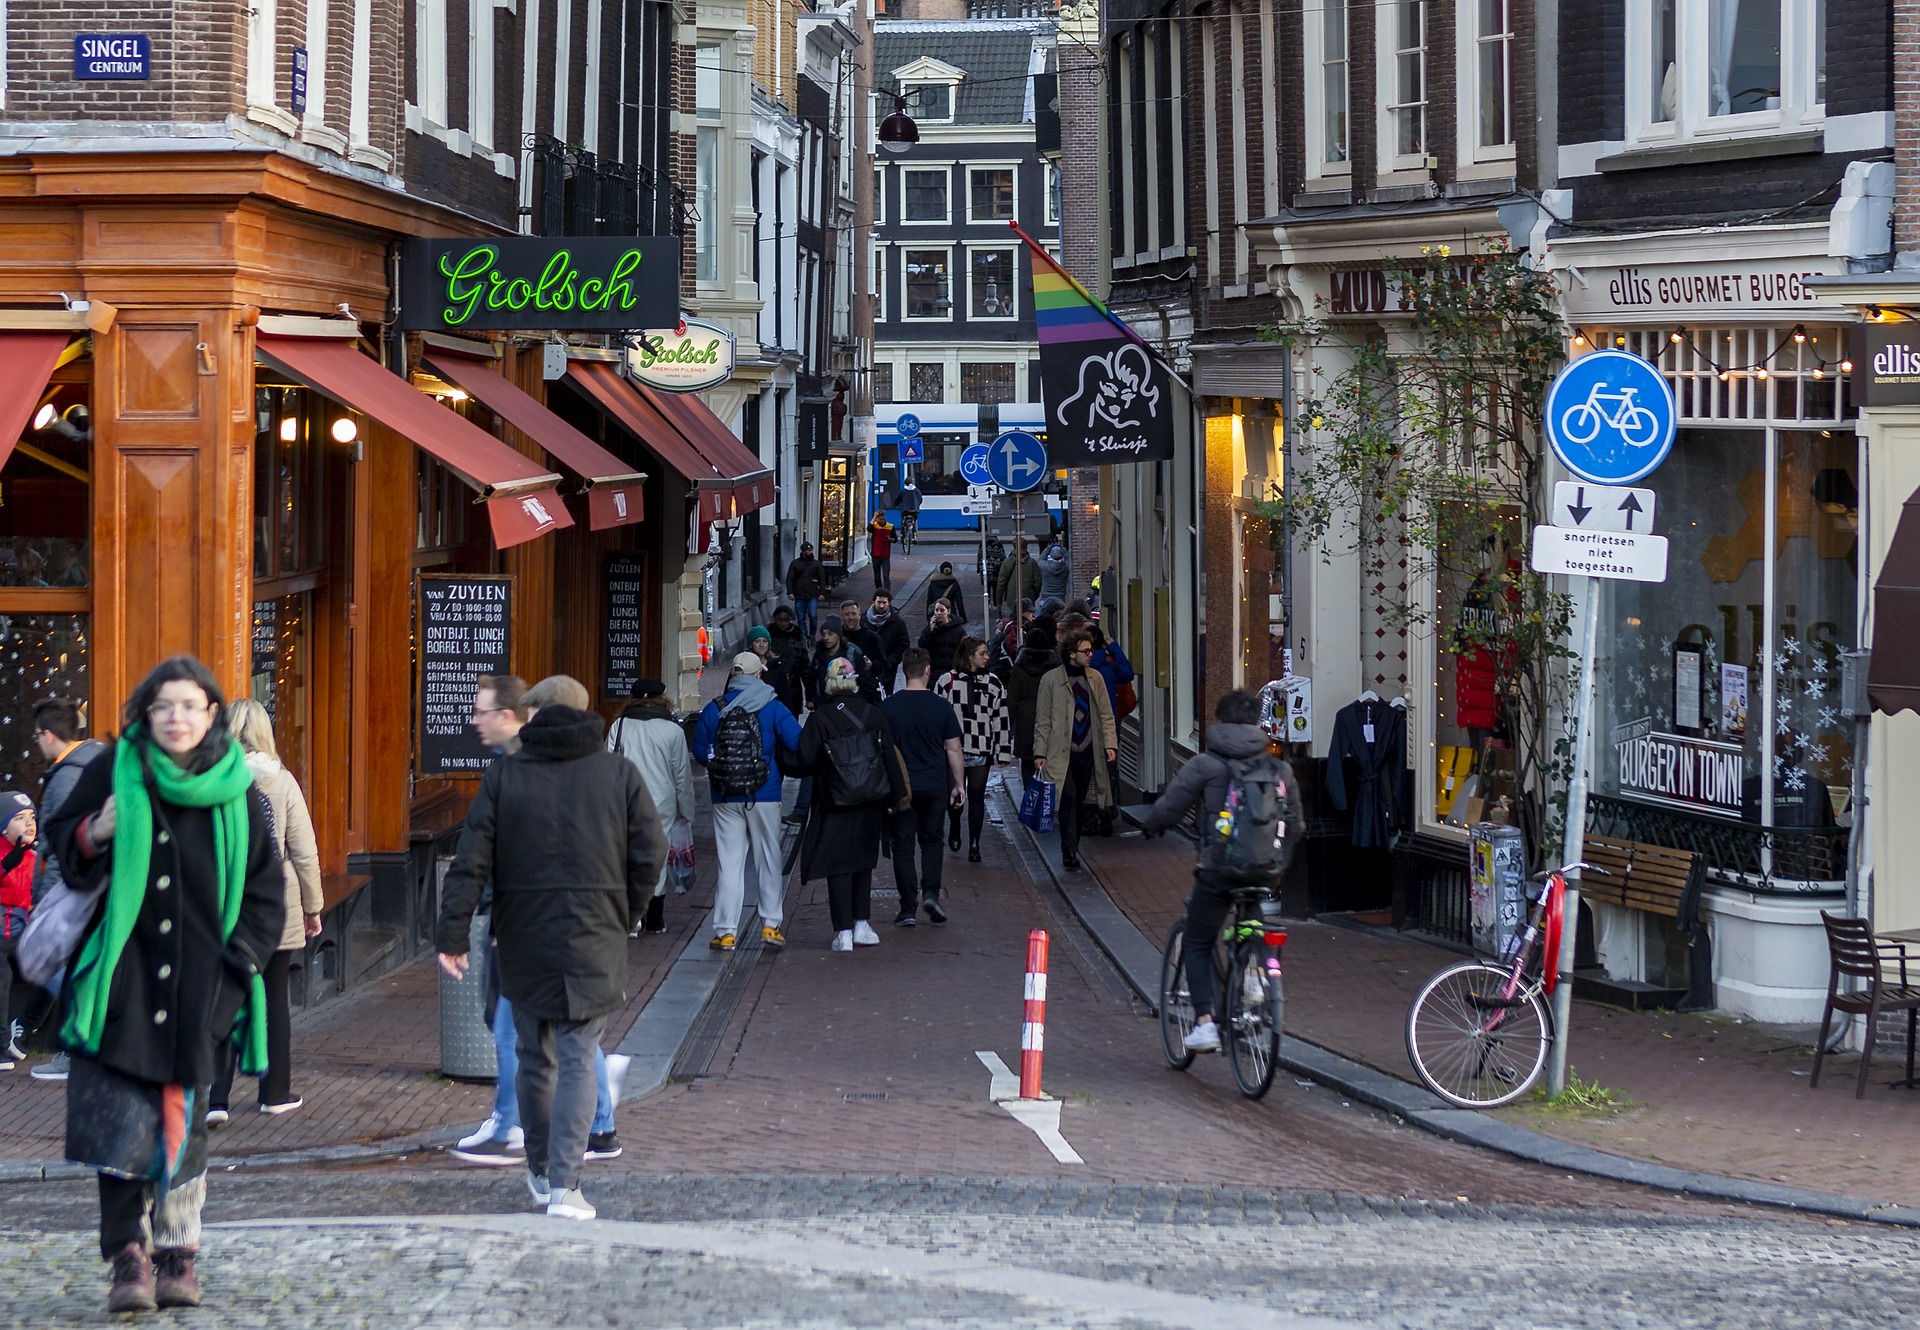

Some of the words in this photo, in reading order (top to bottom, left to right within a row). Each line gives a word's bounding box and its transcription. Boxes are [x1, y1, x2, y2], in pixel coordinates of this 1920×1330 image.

[82, 40, 142, 57] SINGEL
[89, 62, 142, 72] CENTRUM
[439, 245, 642, 326] Grolsch
[1609, 268, 1651, 306] ellis
[1658, 274, 1742, 303] GOURMET
[1750, 272, 1824, 302] BURGE
[1330, 271, 1387, 313] MUD
[1873, 344, 1920, 375] ellis
[1564, 533, 1635, 547] snorfietsen
[1588, 548, 1613, 558] niet
[609, 563, 641, 573] ZUYLEN
[1566, 560, 1634, 574] toegestaan
[609, 581, 640, 591] ONTBIJT
[426, 591, 444, 599] VAN
[448, 585, 506, 600] ZUYLEN
[612, 594, 636, 604] KOFFIE
[612, 607, 638, 617] LUNCH
[609, 620, 639, 630] BIEREN
[474, 628, 505, 640] LUNCH
[608, 633, 640, 643] WIJNEN
[427, 641, 461, 654] BORREL
[463, 642, 470, 654] &
[473, 641, 504, 654] DINER
[610, 646, 639, 657] BORREL
[1300, 637, 1306, 660] 5
[427, 662, 461, 671] GROLSCH
[466, 662, 494, 671] BIEREN
[612, 659, 635, 669] DINER
[427, 673, 478, 681] GRIMBERGEN
[427, 683, 482, 692] SEIZOENSBIER
[426, 694, 478, 703] BITTERBALLE
[426, 705, 454, 714] NACHOS
[459, 705, 473, 713] MET
[426, 715, 462, 724] SPAANSE
[427, 725, 462, 734] WIJNEN
[481, 758, 495, 768] ME
[1620, 739, 1677, 795] BURGER
[1680, 746, 1694, 797] IN
[1698, 749, 1742, 806] TOWN!
